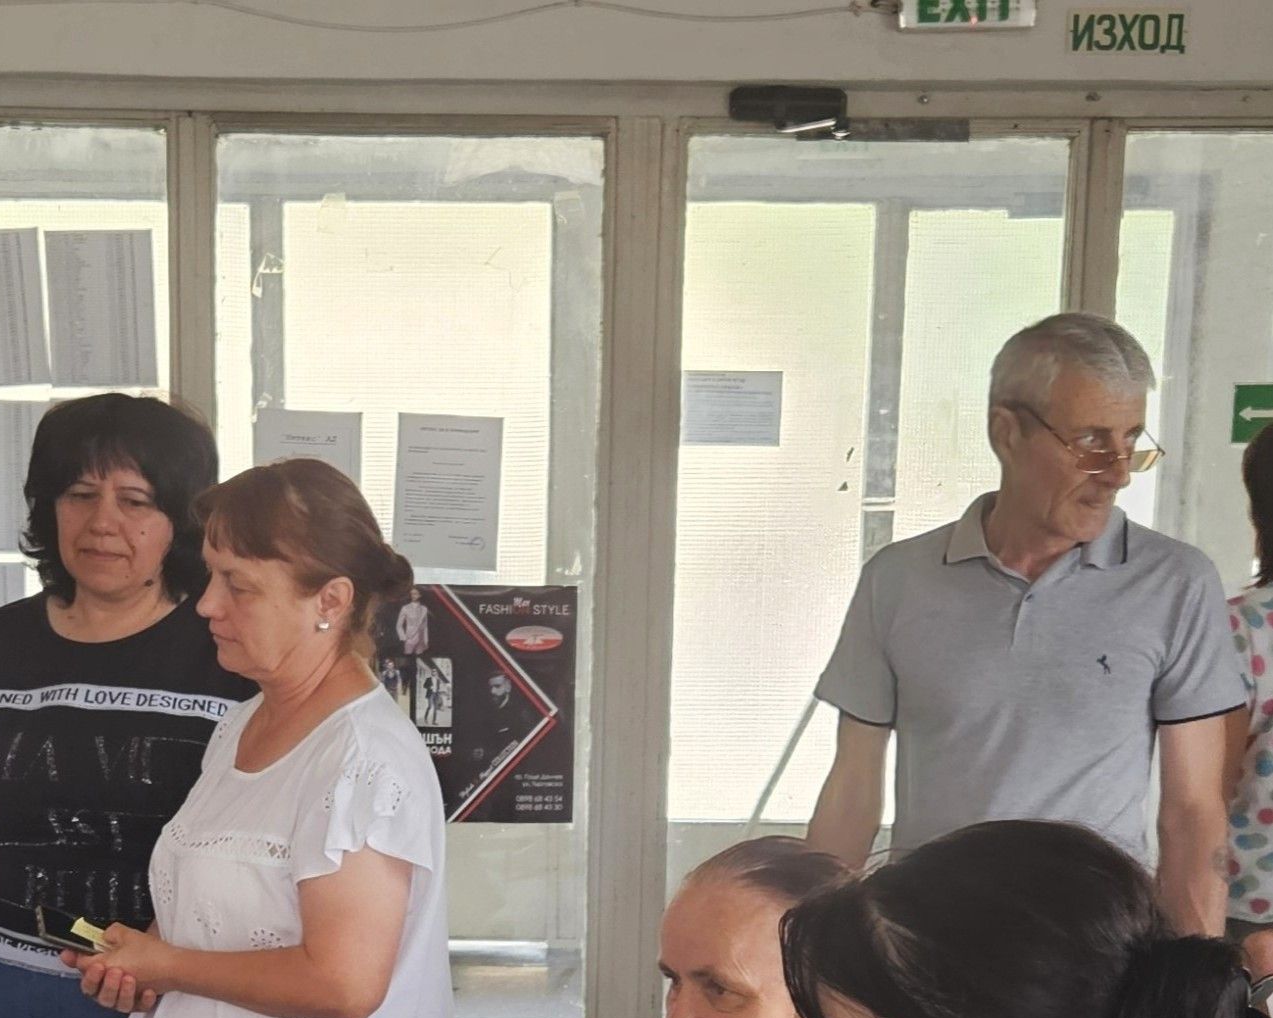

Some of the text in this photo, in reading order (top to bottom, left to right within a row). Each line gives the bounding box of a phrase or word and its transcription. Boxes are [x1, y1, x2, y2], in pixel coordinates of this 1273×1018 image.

[1071, 14, 1186, 54] ИЗХОД
[532, 604, 570, 616] STYLE
[40, 688, 78, 704] WITH
[84, 689, 133, 705] LOVE
[136, 693, 228, 717] DESIGNED
